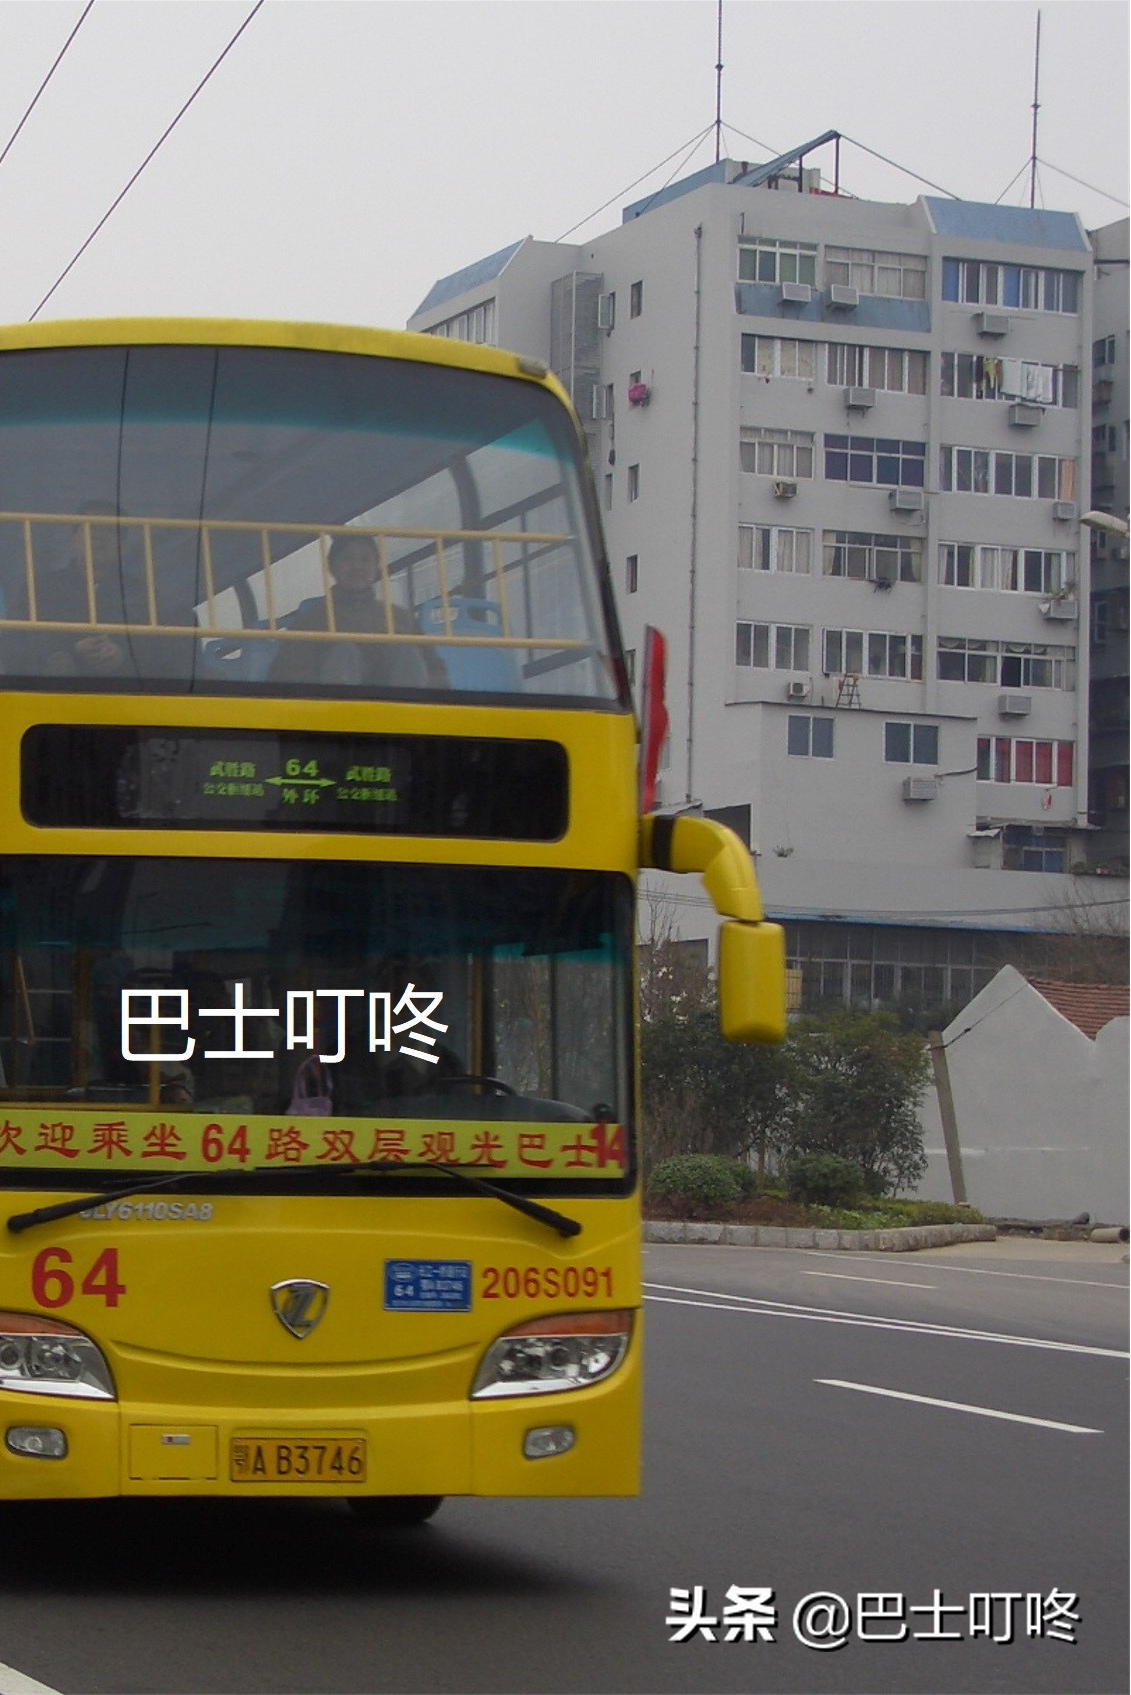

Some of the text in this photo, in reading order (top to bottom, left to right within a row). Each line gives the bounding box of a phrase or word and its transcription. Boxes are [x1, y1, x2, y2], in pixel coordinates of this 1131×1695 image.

[286, 758, 319, 777] 64
[30, 1246, 127, 1309] 64
[481, 1266, 614, 1299] 206S091
